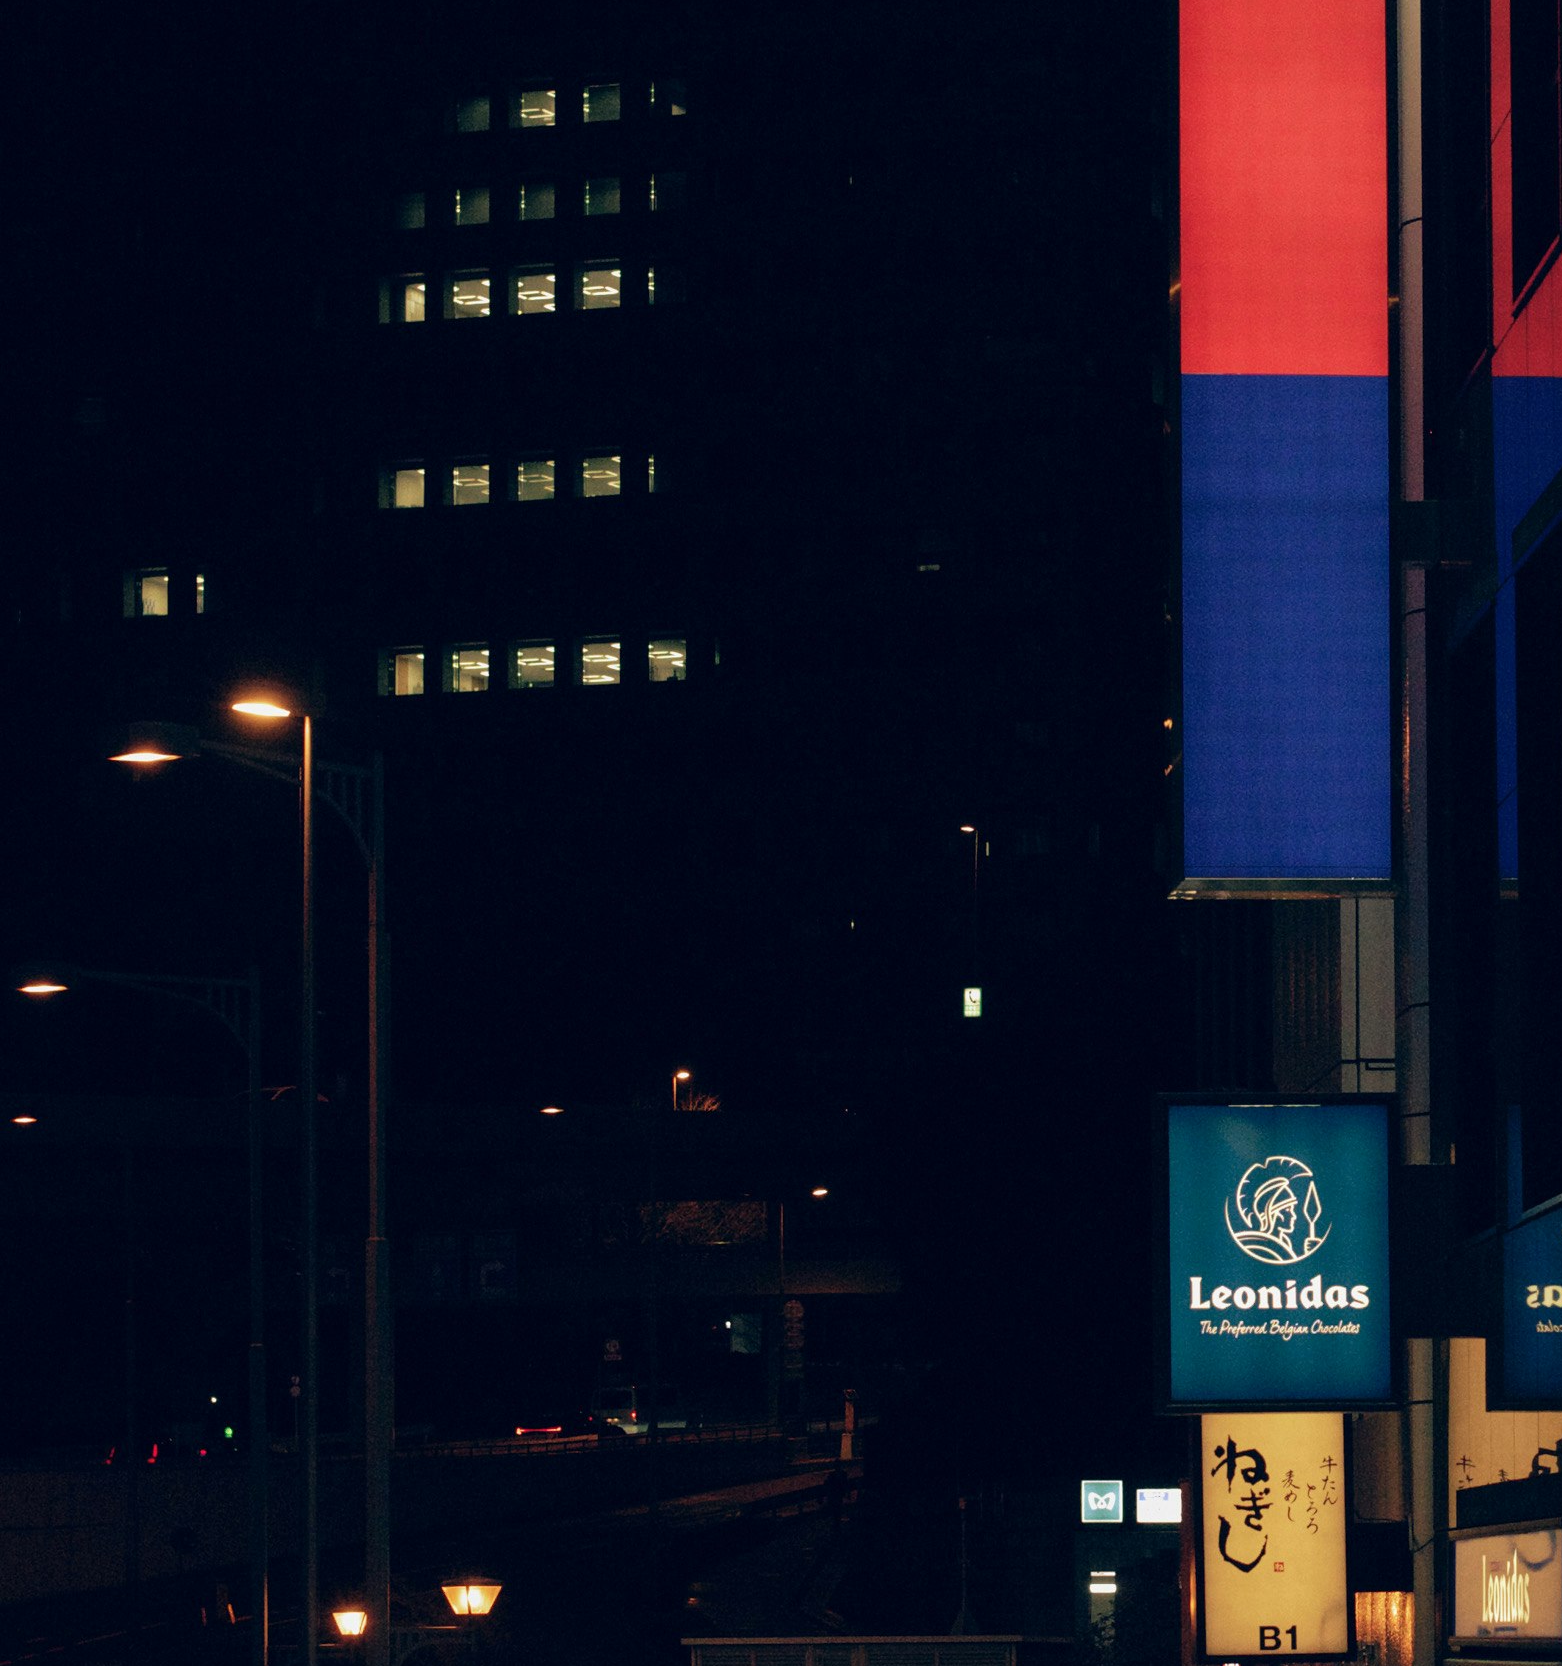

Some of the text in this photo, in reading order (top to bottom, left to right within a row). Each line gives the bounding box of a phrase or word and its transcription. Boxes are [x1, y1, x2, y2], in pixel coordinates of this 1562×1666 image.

[1189, 1274, 1370, 1310] Leonidas
[1200, 1319, 1360, 1341] The Preferred Belgian Chocolates
[1211, 1435, 1273, 1573] ねぎし
[1281, 1469, 1301, 1523] 麦めし
[1320, 1455, 1338, 1506] 牛たん
[1306, 1483, 1319, 1535] とろろ
[1482, 1548, 1530, 1624] Leonidas
[1259, 1625, 1297, 1651] B1
